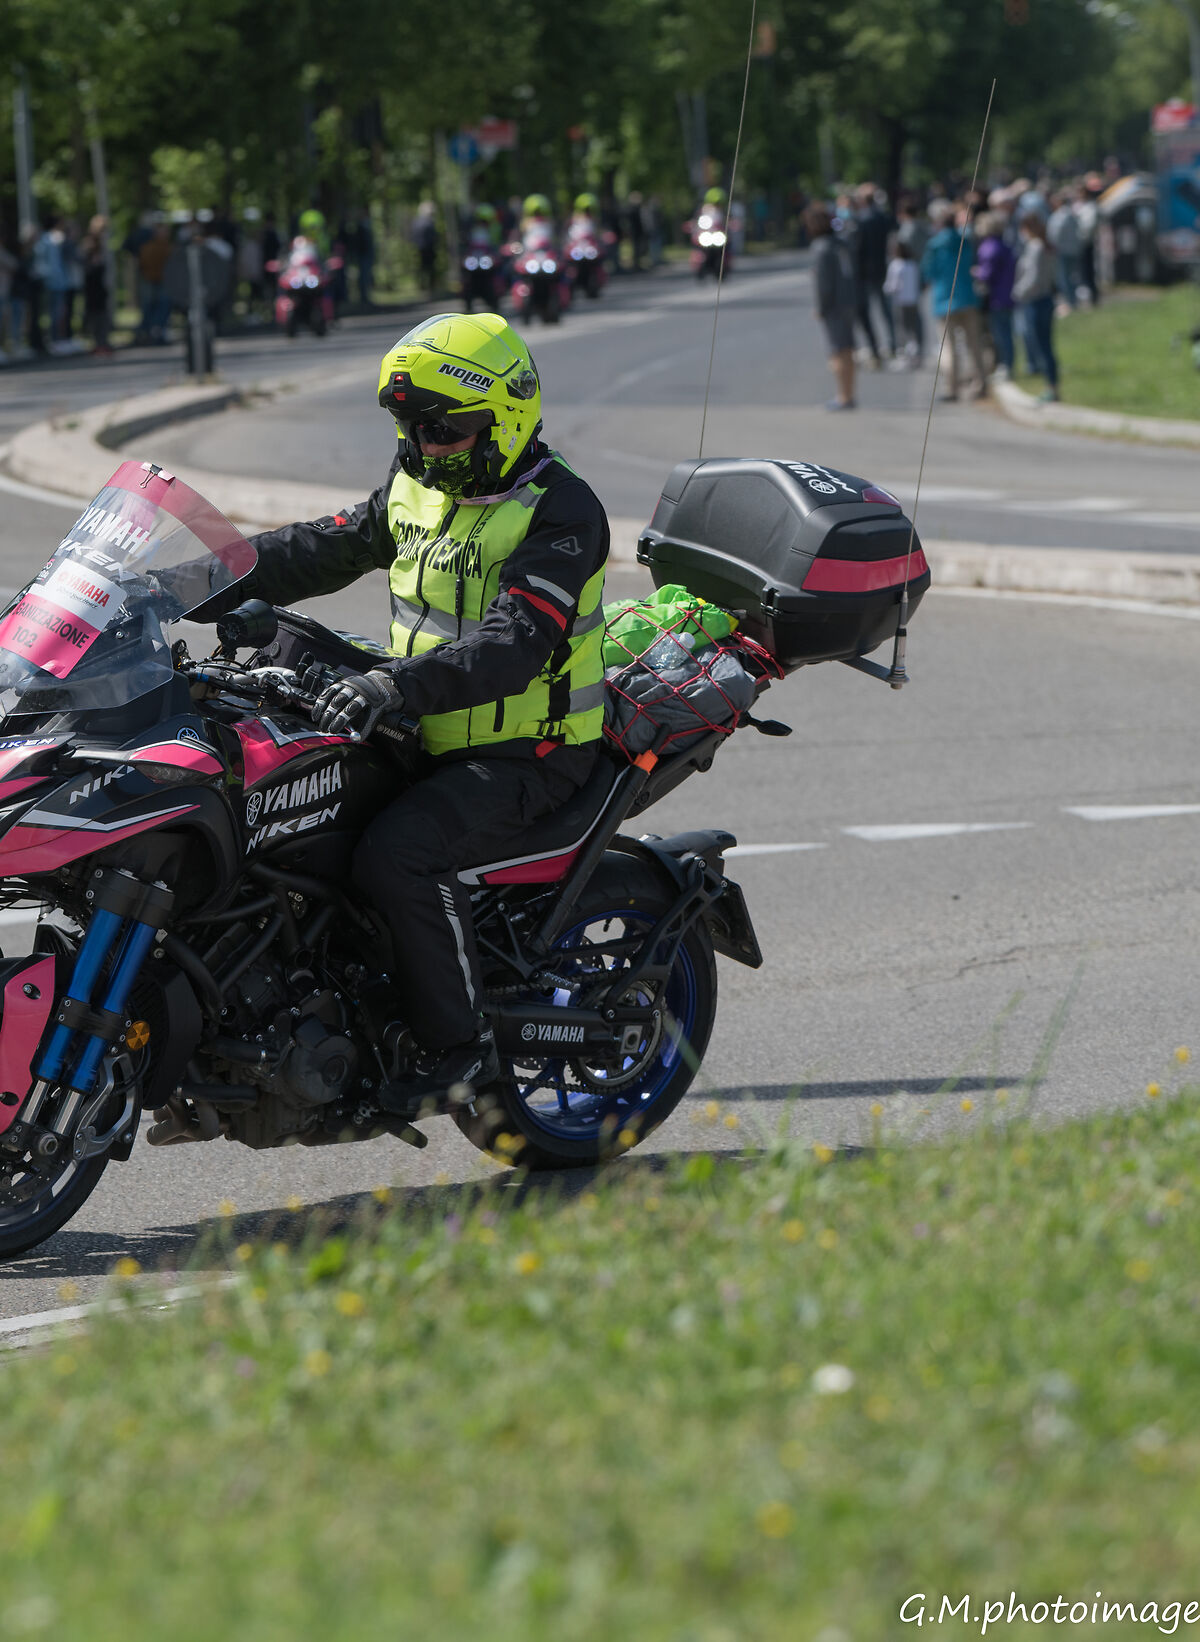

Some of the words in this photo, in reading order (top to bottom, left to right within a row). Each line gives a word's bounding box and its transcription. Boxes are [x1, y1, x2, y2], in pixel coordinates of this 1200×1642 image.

[438, 362, 495, 393] NOLAN
[57, 538, 139, 581] IKEN
[427, 537, 483, 579] TECNCA
[70, 575, 111, 608] YAMAHA
[11, 625, 38, 648] 102
[13, 601, 90, 649] GANIZZAZIONE
[382, 724, 406, 742] YAMAHA
[69, 764, 136, 805] NIK
[263, 761, 343, 815] YAMAHA
[246, 802, 342, 856] NIKEN
[538, 1024, 584, 1043] YAMAHA
